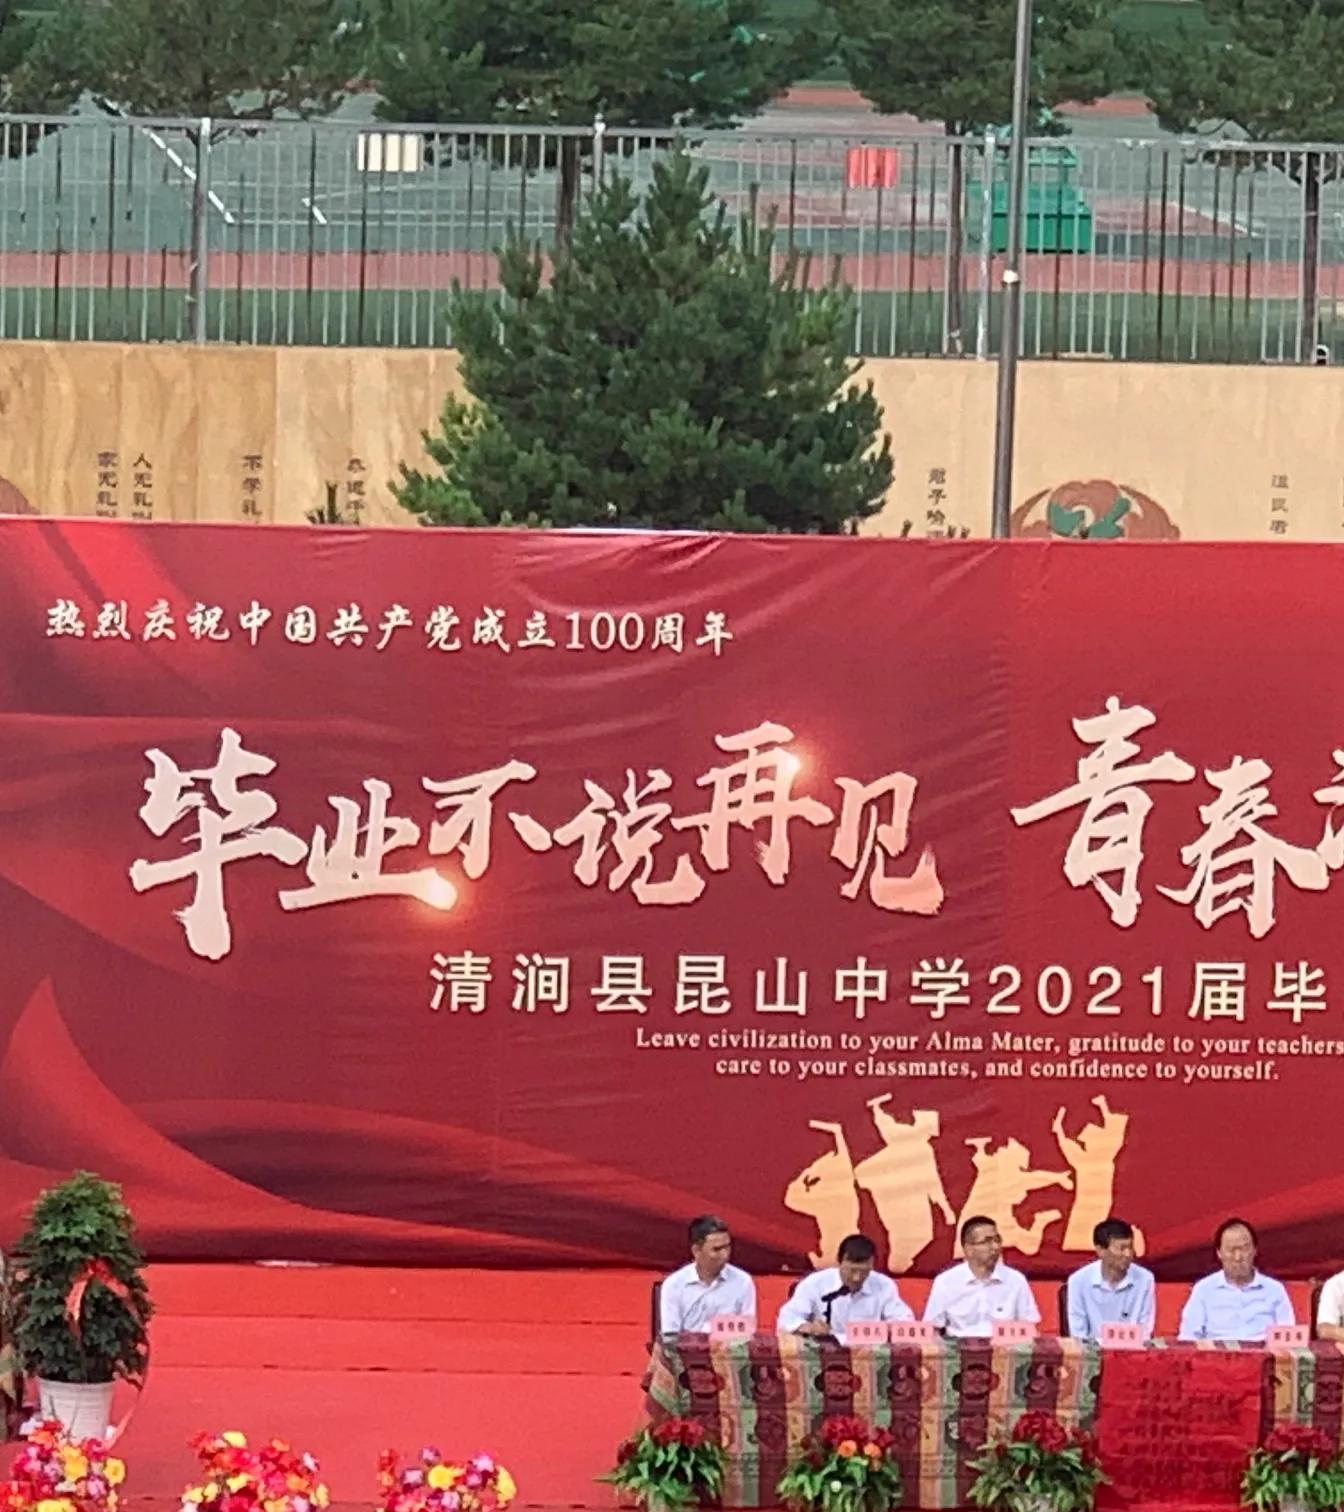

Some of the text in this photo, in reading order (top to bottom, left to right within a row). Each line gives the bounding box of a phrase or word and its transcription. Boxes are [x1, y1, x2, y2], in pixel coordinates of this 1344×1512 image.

[45, 598, 735, 656] 热烈庆祝中国共产党成立100周年
[128, 719, 946, 961] 毕业不说再见
[636, 1027, 701, 1048] Leave
[708, 1028, 833, 1050] civilization
[840, 1032, 862, 1050] to
[867, 1035, 919, 1055] your
[925, 1030, 984, 1051] Alma
[990, 1031, 1061, 1054] Mater,
[1067, 1033, 1165, 1057] gratitude
[1173, 1035, 1195, 1053] to
[1201, 1039, 1250, 1058] your
[715, 1057, 1280, 1084] care to your classmates, and confidence to yourself.
